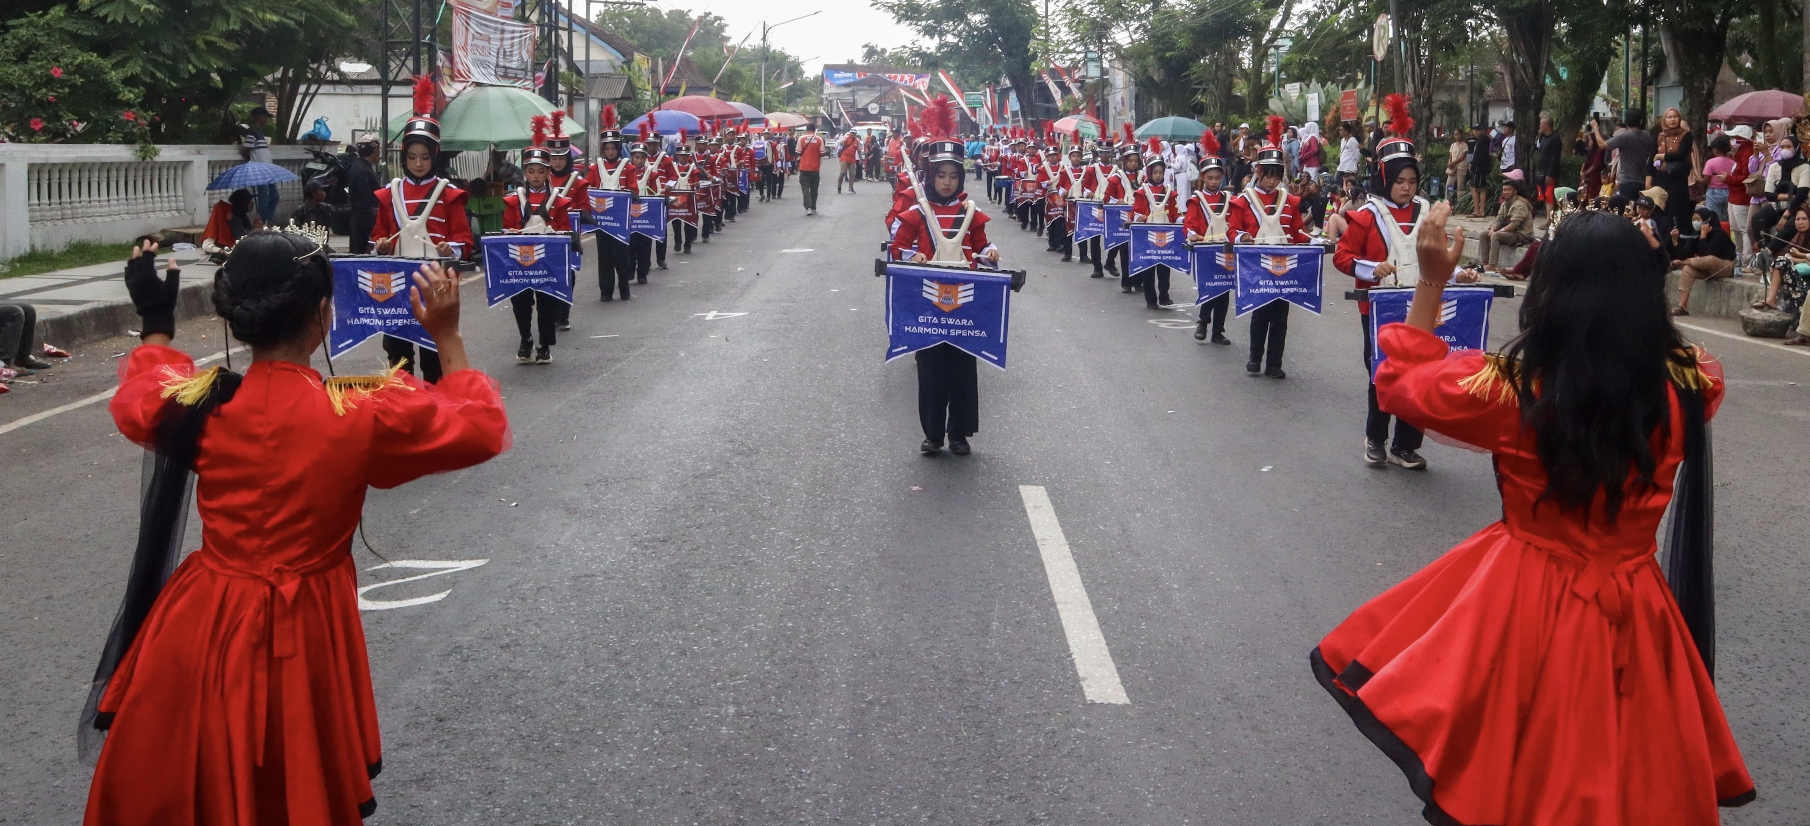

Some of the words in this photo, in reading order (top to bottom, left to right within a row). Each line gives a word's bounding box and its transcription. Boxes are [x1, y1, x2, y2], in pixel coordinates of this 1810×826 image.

[940, 318, 974, 326] SWARA
[904, 326, 948, 335] HARMONI
[950, 329, 987, 337] SPENSA
